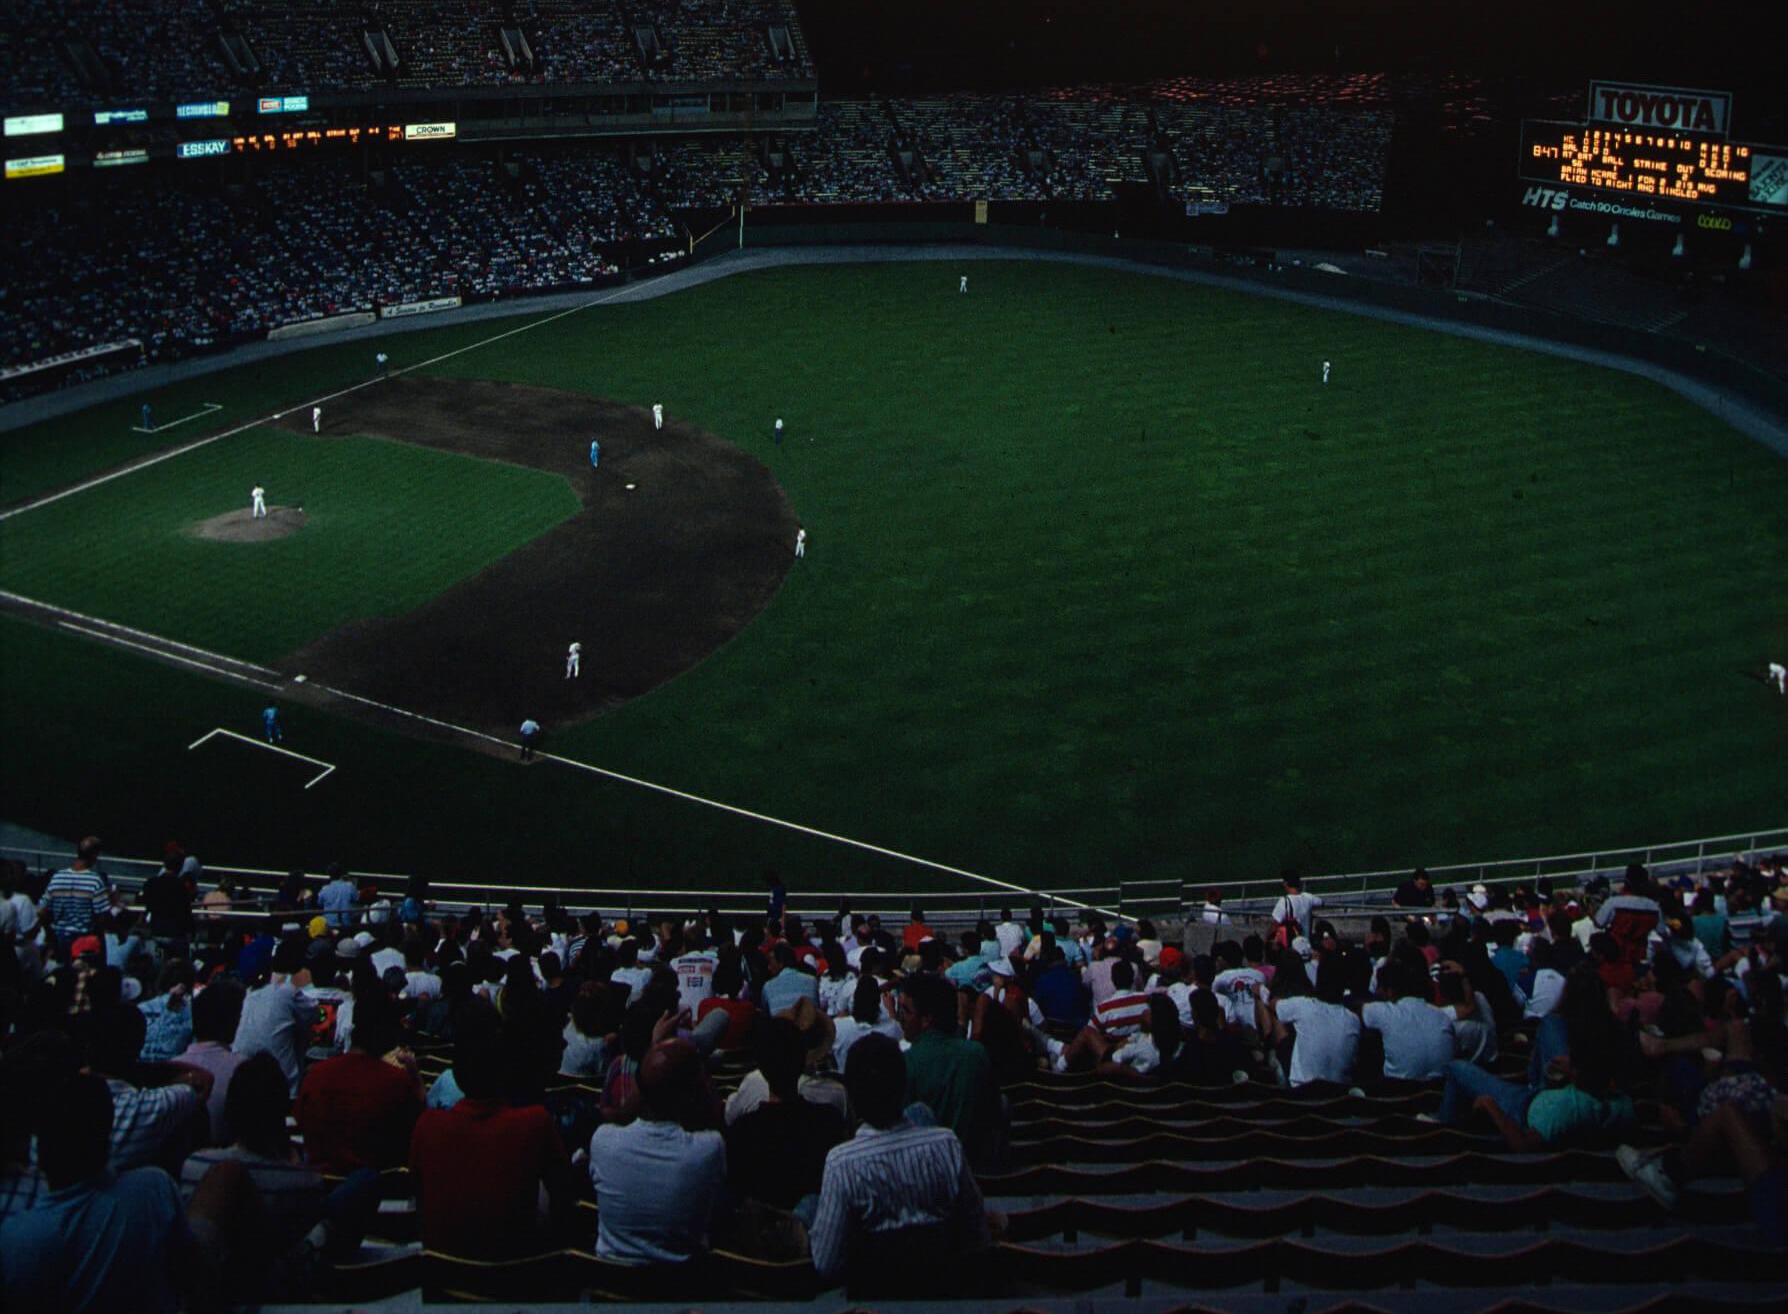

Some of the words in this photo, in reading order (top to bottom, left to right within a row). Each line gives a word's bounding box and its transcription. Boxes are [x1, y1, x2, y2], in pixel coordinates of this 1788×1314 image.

[1600, 90, 1715, 130] TOYOTA
[416, 126, 446, 135] CROWN
[183, 142, 226, 156] ESSKAY
[1602, 155, 1624, 166] BALL
[1633, 158, 1668, 172] STRIKE
[1676, 164, 1695, 175] OUT
[1704, 168, 1747, 182] SCORING
[1560, 173, 1587, 184] FLIED
[1591, 177, 1603, 187] TO
[1605, 179, 1634, 190] RIGHT
[1637, 183, 1655, 194] AND
[1659, 185, 1699, 199] SINGLED
[1521, 187, 1569, 211] HTS
[1569, 198, 1598, 212] Catch
[1611, 204, 1646, 219] Orioles
[1646, 209, 1682, 224] Games
